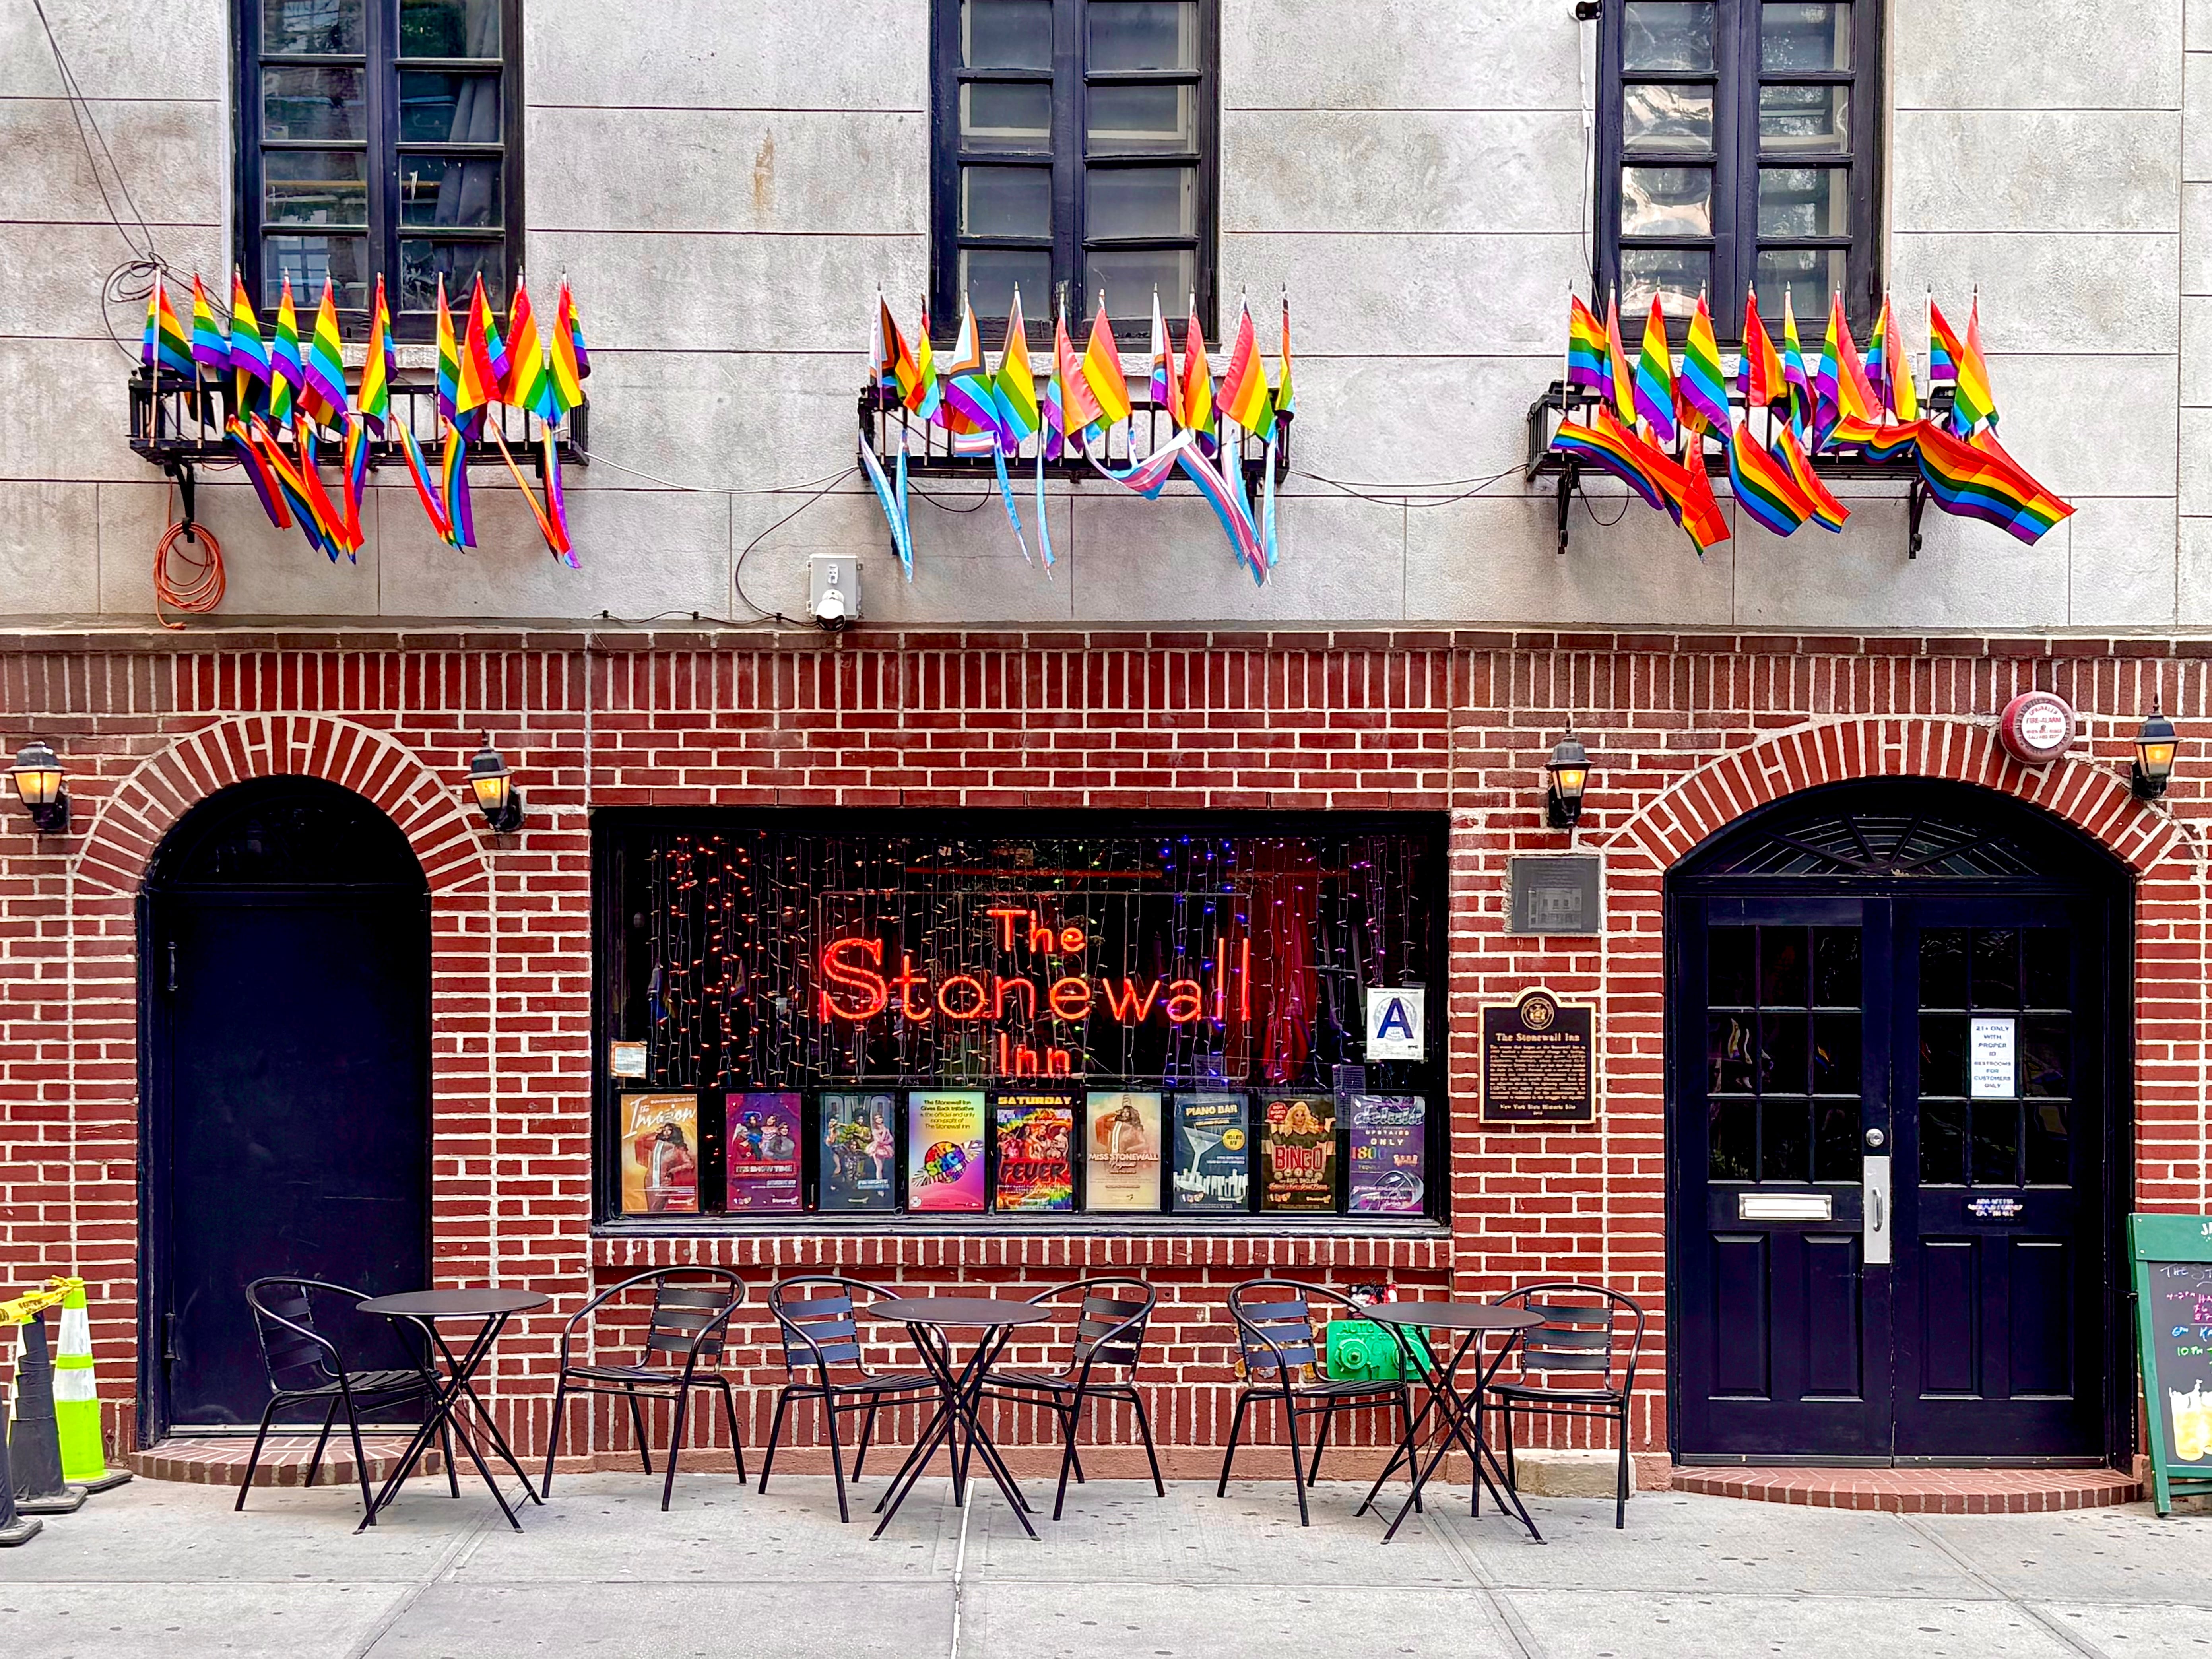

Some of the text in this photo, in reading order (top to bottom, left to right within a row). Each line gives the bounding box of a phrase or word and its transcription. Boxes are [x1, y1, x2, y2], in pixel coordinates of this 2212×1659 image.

[986, 909, 1086, 953] The
[820, 937, 1250, 1024] Stonewall
[1376, 997, 1414, 1038] A
[1496, 1032, 1580, 1042] The Stonewall Inn
[1000, 1032, 1071, 1078] Inn
[1186, 1104, 1238, 1116] PIANO BAR
[1110, 1153, 1158, 1162] STONEWALL
[1275, 1146, 1323, 1169] BINGO
[1352, 1146, 1386, 1160] 1800
[2160, 1263, 2189, 1278] THE
[1340, 1323, 1374, 1333] AUTO
